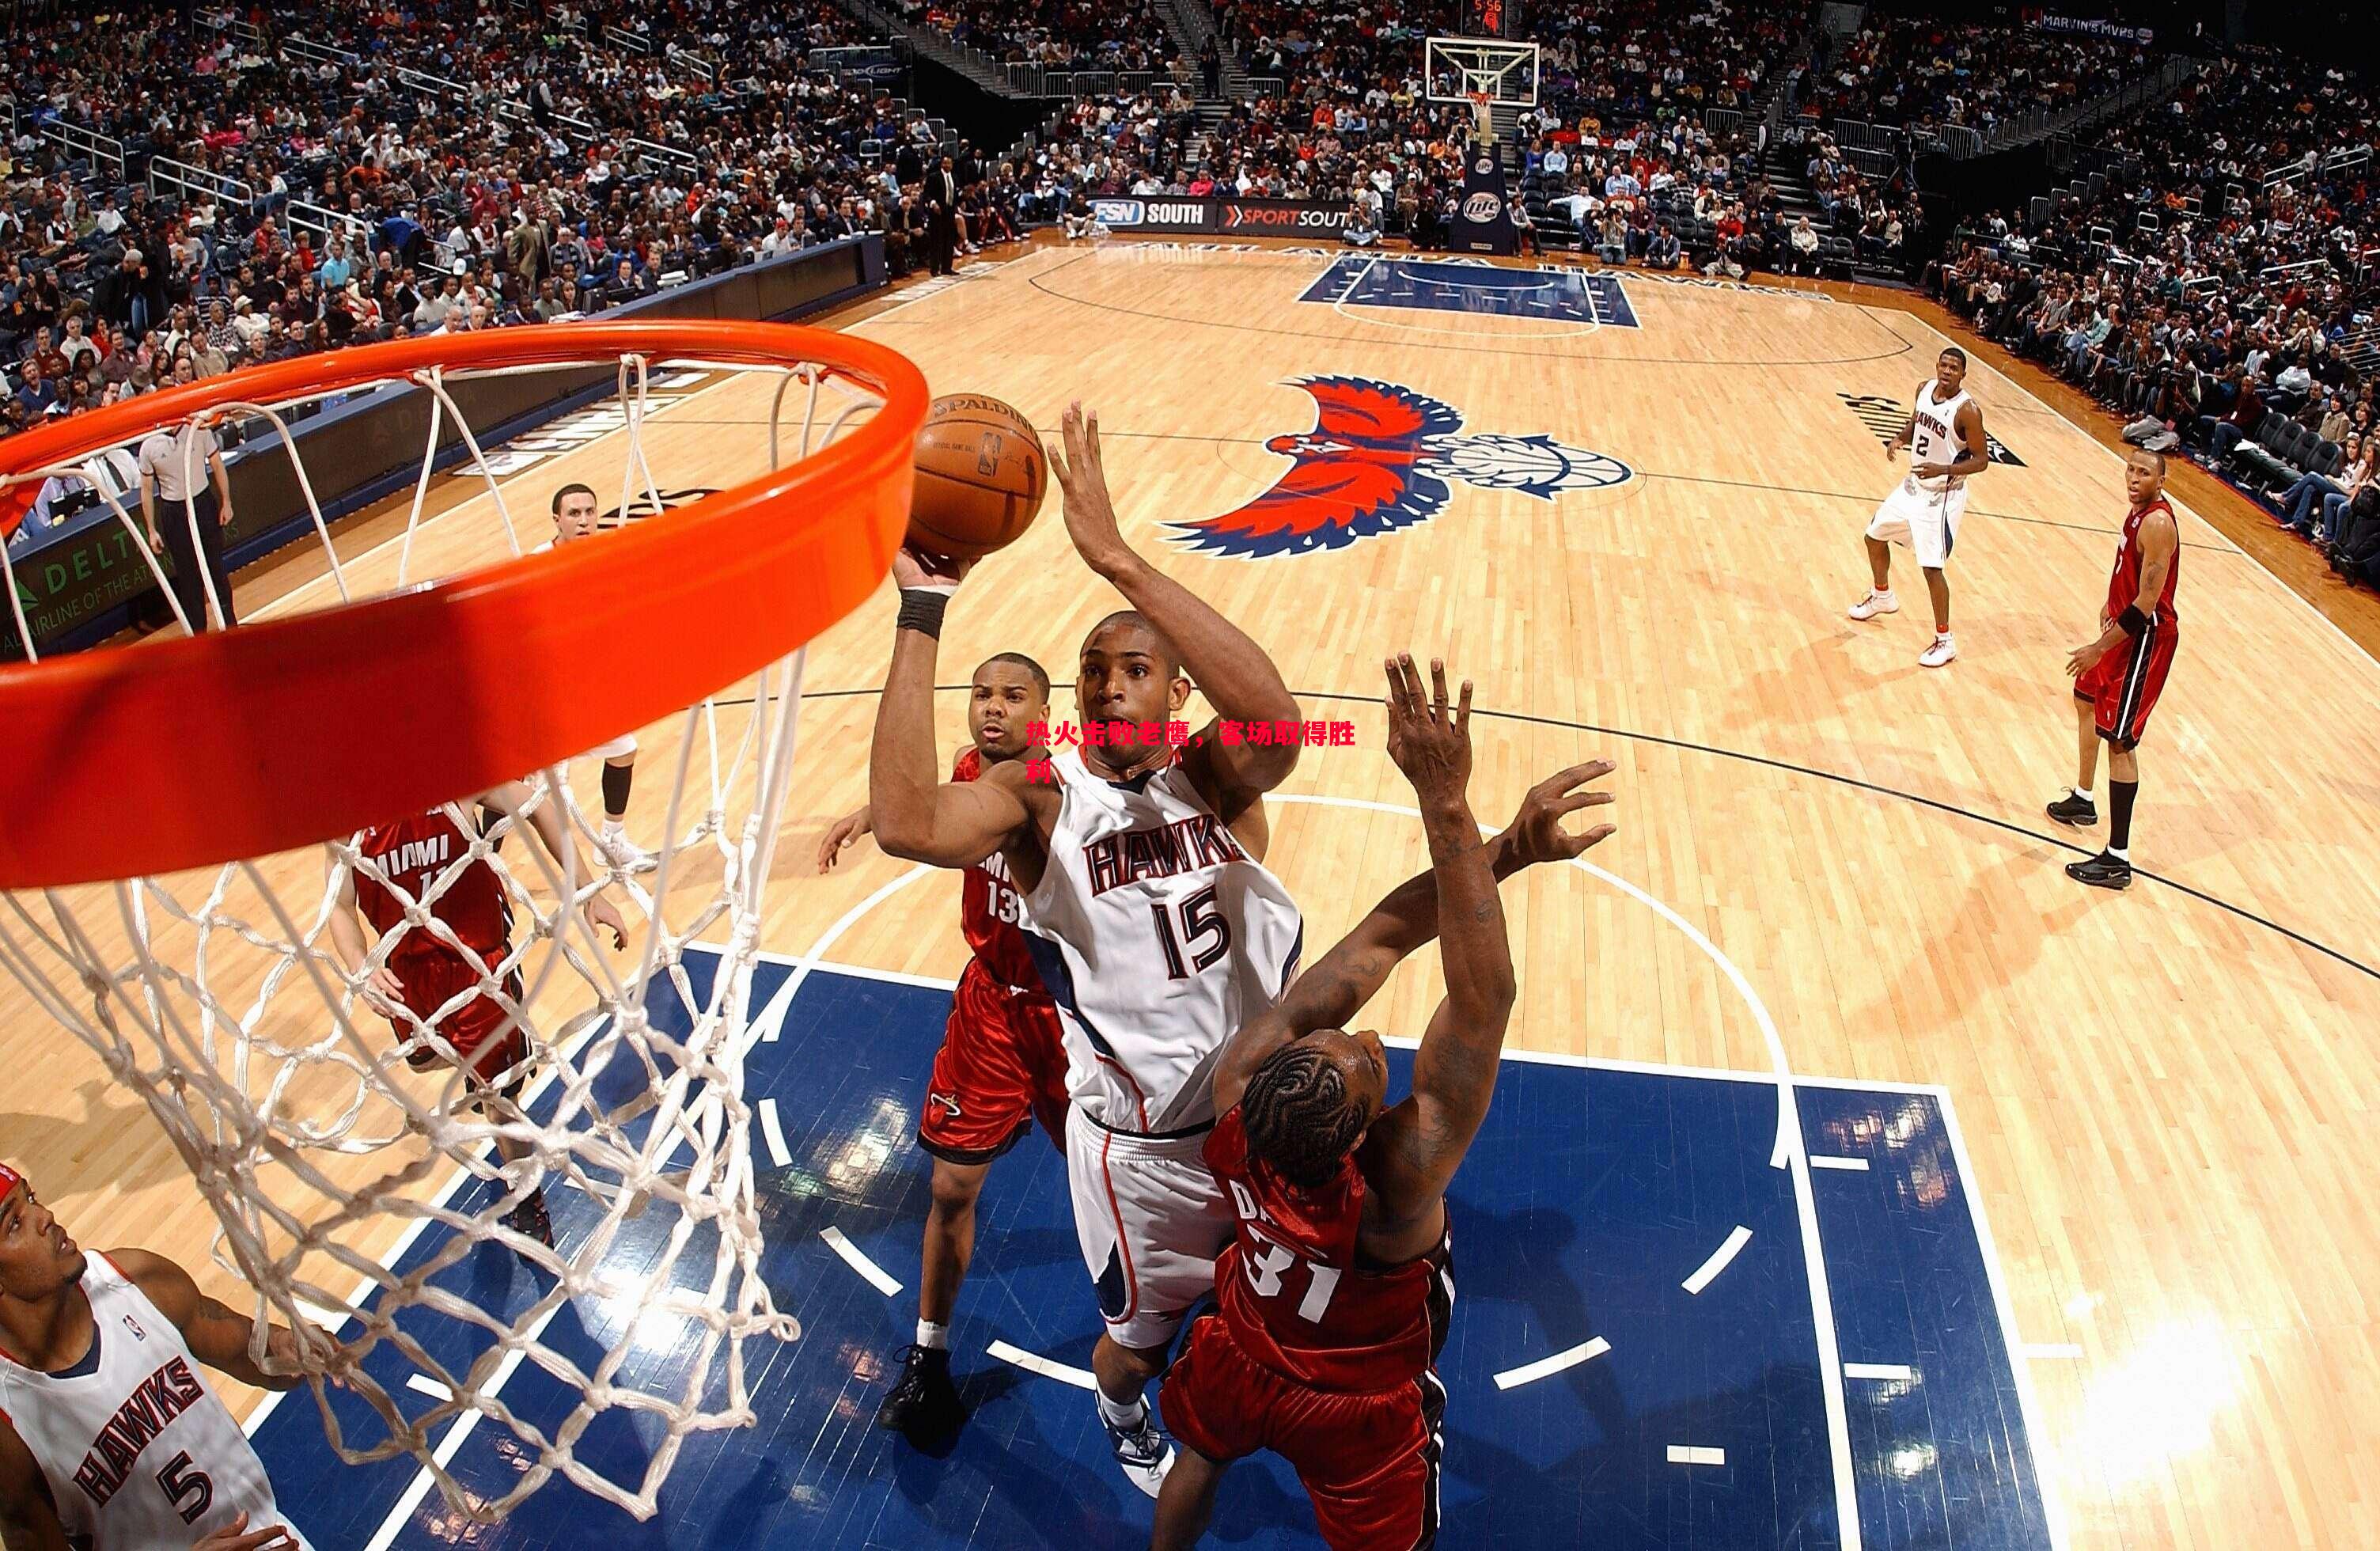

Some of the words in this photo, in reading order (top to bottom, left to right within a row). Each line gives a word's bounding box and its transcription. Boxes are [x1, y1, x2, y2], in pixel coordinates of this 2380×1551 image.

[1475, 0, 1502, 12] 5:56
[2043, 15, 2098, 33] MARVIN'S
[1095, 203, 1136, 222] FSN
[1147, 203, 1203, 224] SOUTH
[1242, 209, 1352, 228] SPORTSOUT
[1916, 434, 1930, 457] 2
[104, 577, 131, 605] THE
[987, 880, 1018, 923] 13
[1150, 883, 1232, 980] 15
[1241, 1223, 1343, 1324] 31
[72, 1355, 205, 1508] HAWKS
[154, 1449, 213, 1526] 5
